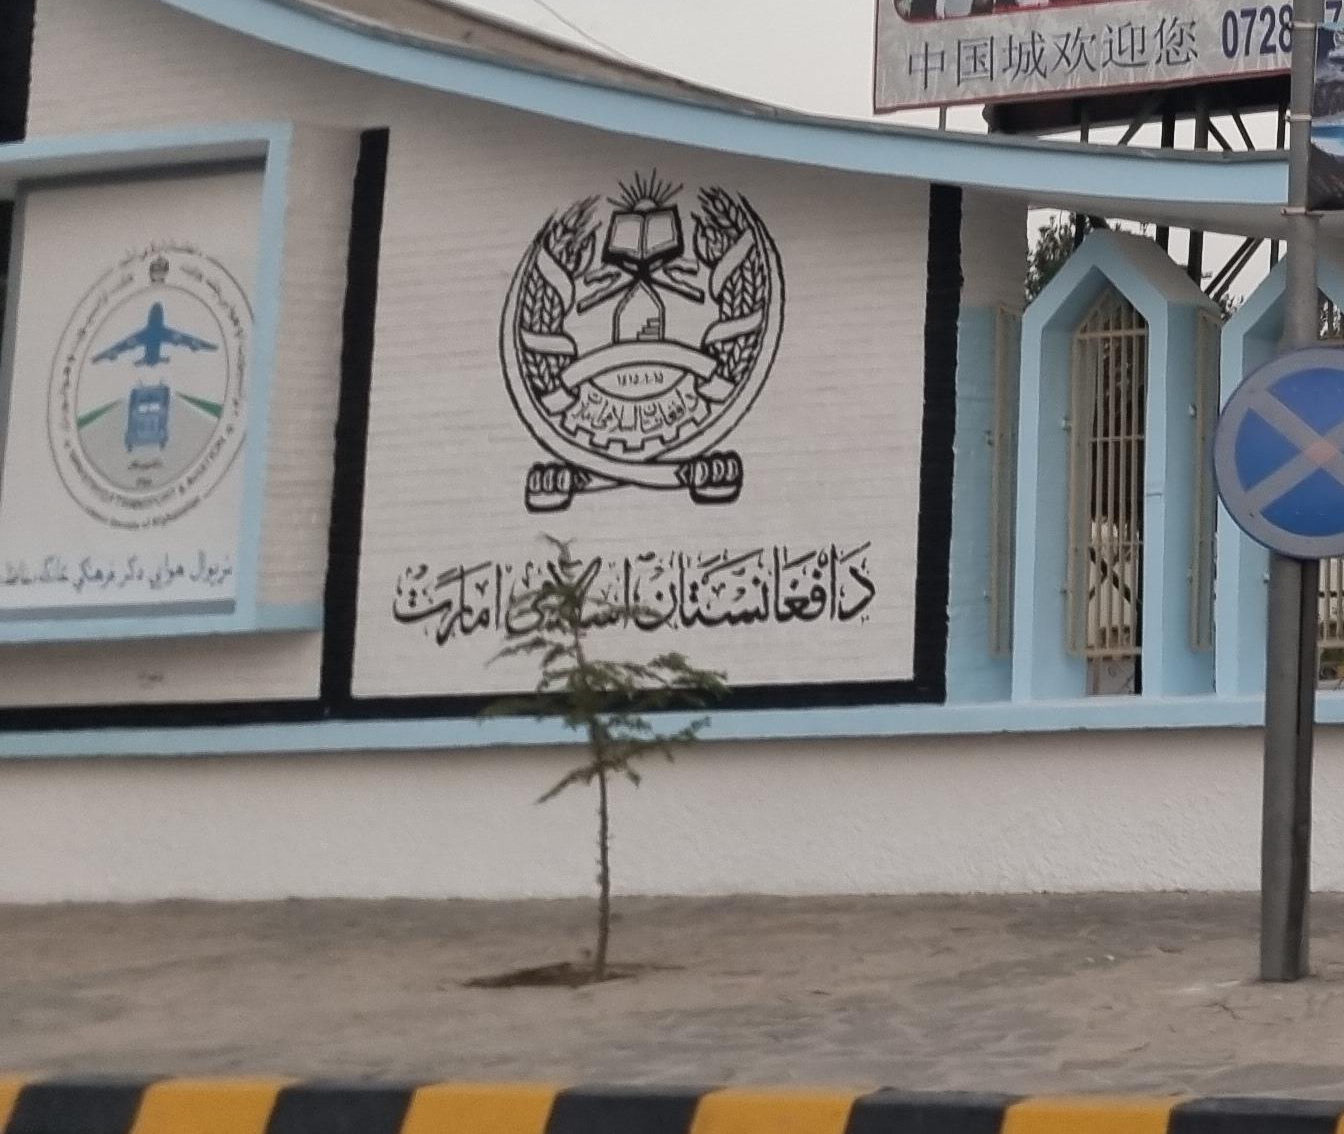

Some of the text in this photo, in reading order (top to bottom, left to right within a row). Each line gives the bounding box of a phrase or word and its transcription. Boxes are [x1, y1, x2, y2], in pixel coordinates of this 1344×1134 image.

[907, 14, 1200, 91] 中国城欢迎您
[1221, 3, 1293, 60] 0728
